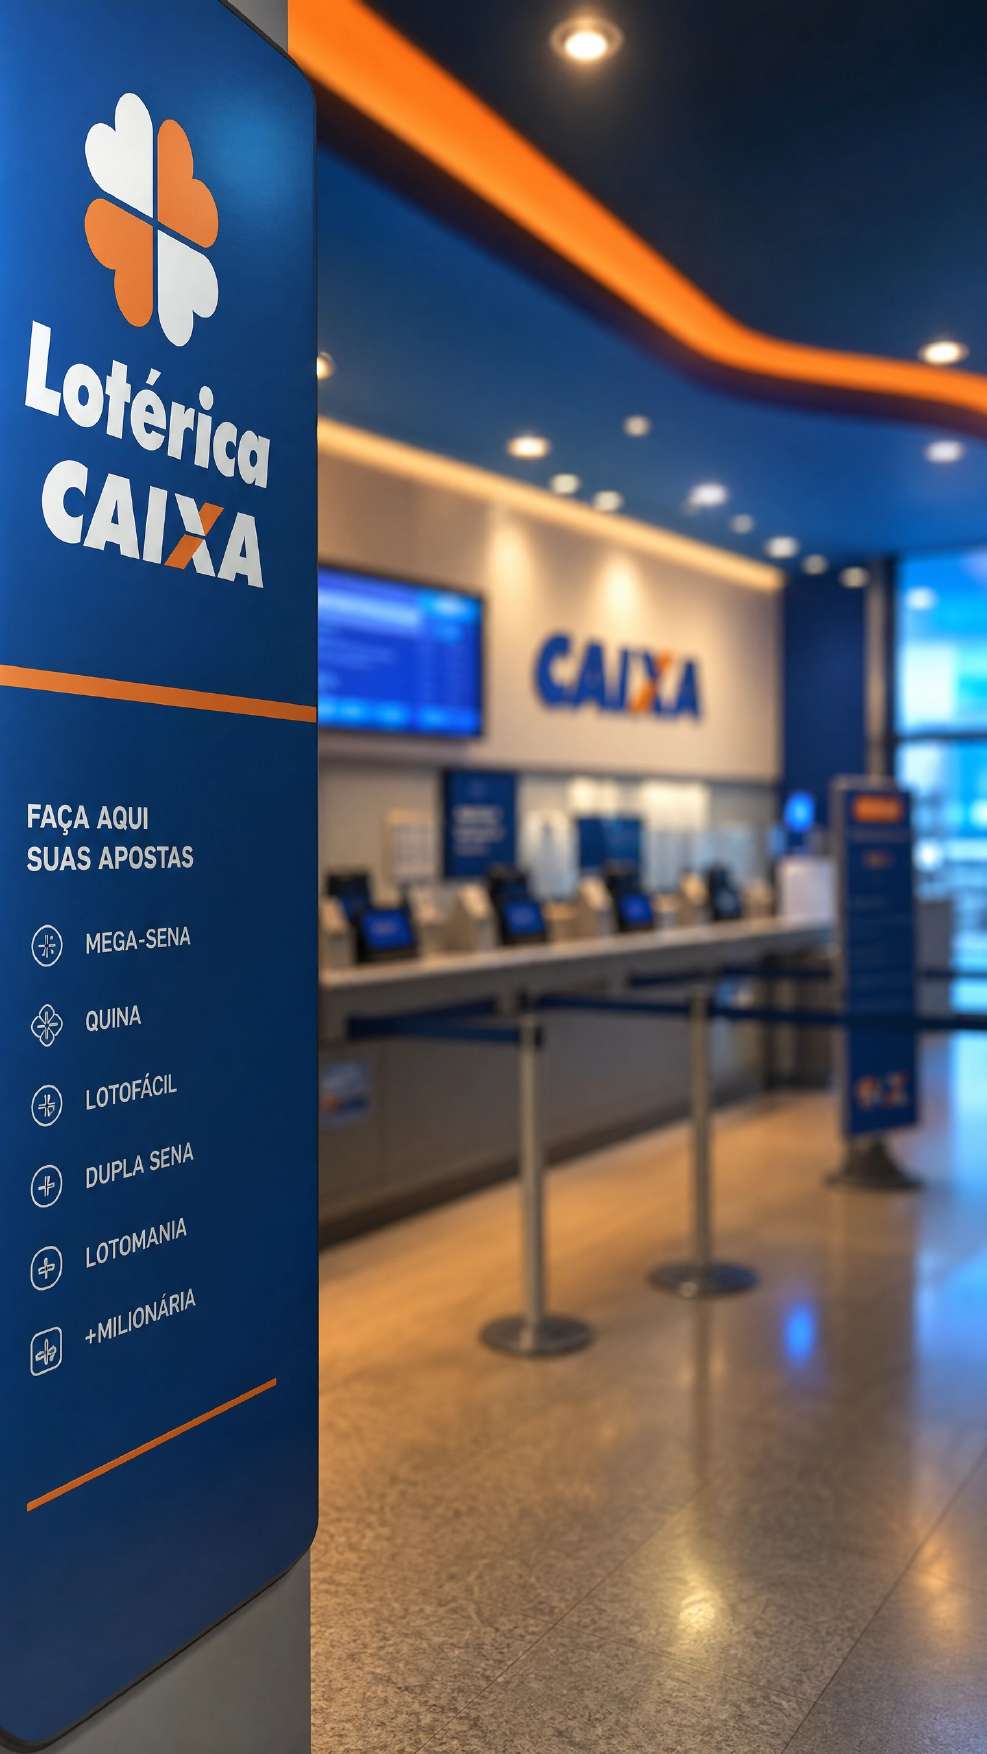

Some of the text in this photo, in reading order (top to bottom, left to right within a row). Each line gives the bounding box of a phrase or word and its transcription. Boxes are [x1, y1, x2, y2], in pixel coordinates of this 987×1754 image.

[25, 320, 270, 489] Lotérica
[41, 459, 264, 589] CAIXA
[533, 632, 703, 720] CAIXA
[27, 803, 149, 836] FAÇA AQUI
[27, 845, 194, 872] SUAS APOSTAS
[85, 926, 191, 954] MEGA-SENA
[85, 1004, 142, 1032] QUINA
[86, 1072, 178, 1110] LOTOFÁCIL
[86, 1142, 194, 1189] DUPLA SENA
[86, 1217, 187, 1268] LOTOMANIA
[85, 1288, 196, 1344] +MILIONÁRIA
